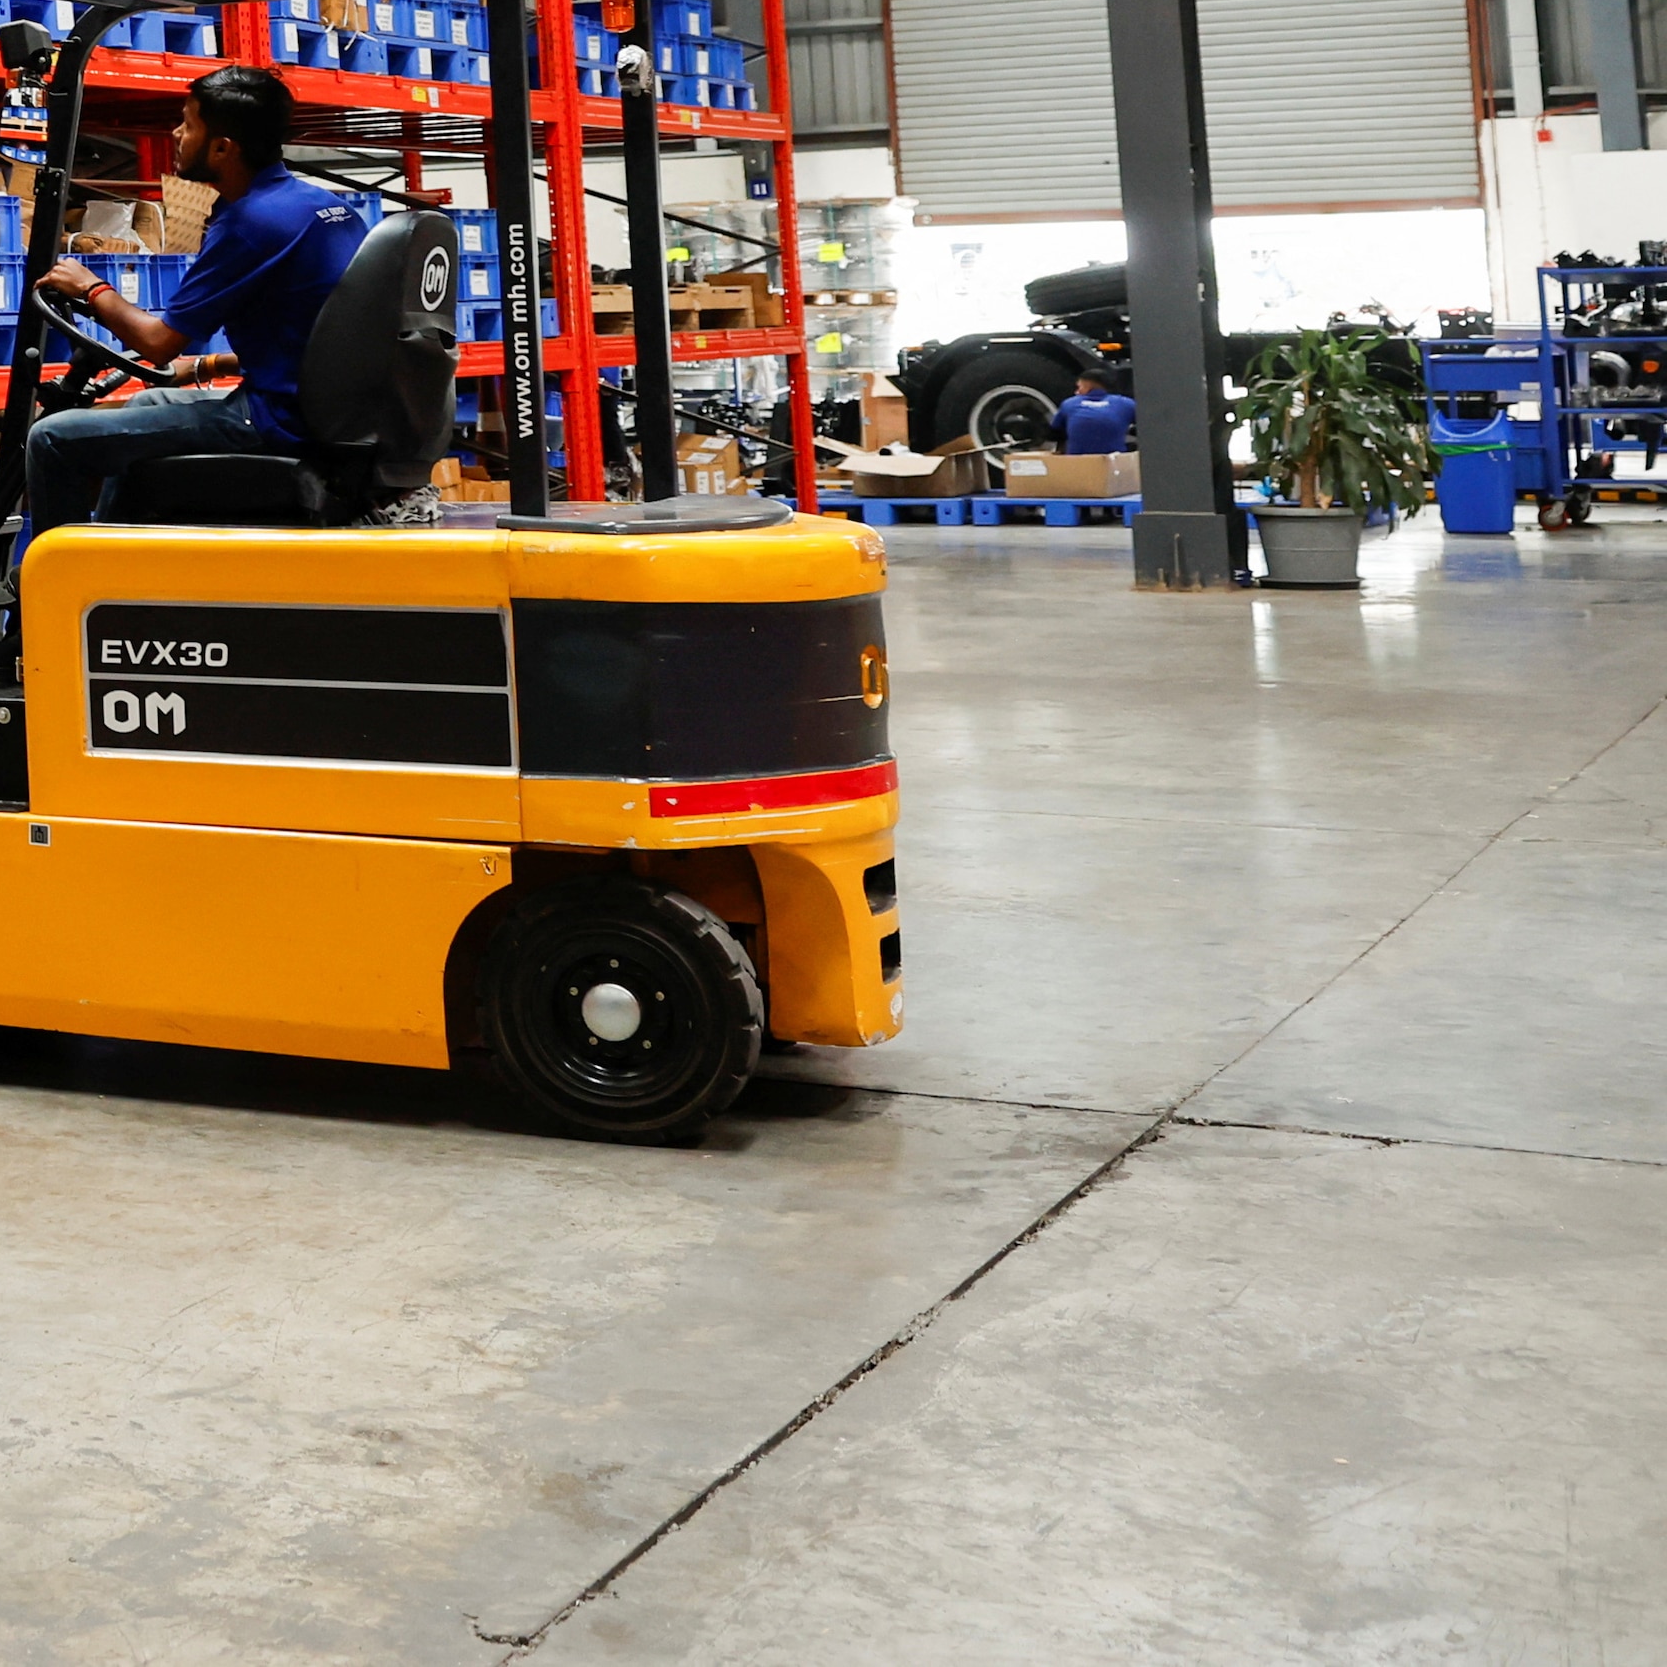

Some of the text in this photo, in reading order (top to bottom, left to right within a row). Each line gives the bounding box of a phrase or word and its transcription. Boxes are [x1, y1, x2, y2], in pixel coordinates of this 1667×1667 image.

[425, 263, 445, 294] OM
[508, 223, 534, 438] www.om mh.com
[101, 639, 229, 669] EVX30
[103, 691, 186, 735] OM
